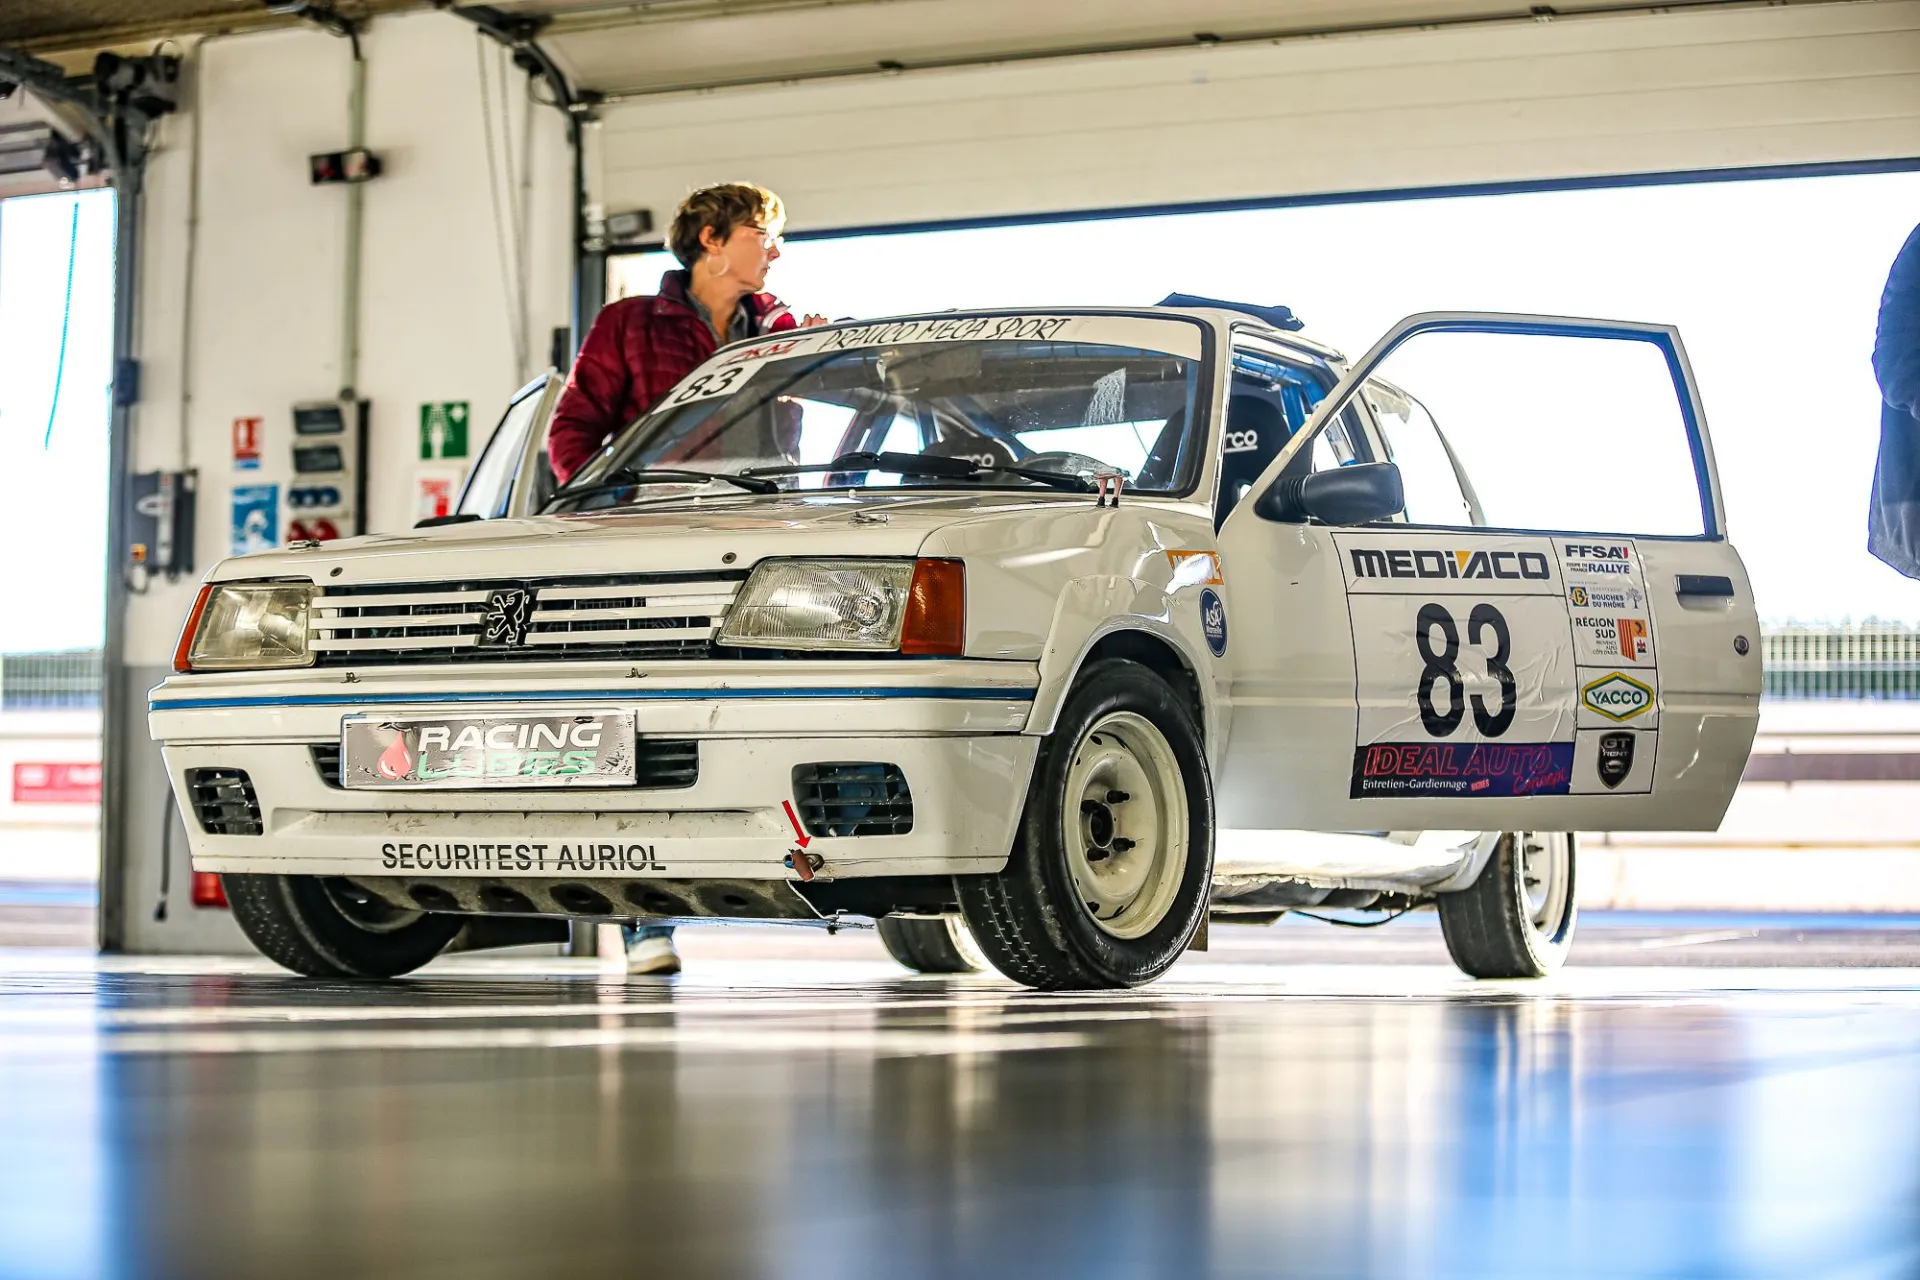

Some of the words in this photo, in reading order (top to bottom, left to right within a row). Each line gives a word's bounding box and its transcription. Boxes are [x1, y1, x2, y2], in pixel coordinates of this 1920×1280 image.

[915, 318, 987, 341] MECA
[985, 316, 1073, 341] SPORT
[673, 367, 744, 404] 83
[1565, 544, 1624, 559] FFSA
[1588, 562, 1630, 575] RALLYE
[1591, 593, 1624, 602] BOUCHES
[1603, 601, 1626, 609] RHÔNE
[1575, 616, 1615, 628] RÉGION
[1595, 629, 1616, 639] SUD
[1416, 603, 1518, 738] 83
[1592, 691, 1643, 705] YACCO
[418, 722, 603, 751] RACING
[1603, 738, 1631, 749] GT
[1363, 745, 1460, 777] IDEAL
[1462, 744, 1552, 776] AUTO
[1362, 778, 1467, 792] Entretien-Gardiennage
[381, 843, 548, 870] SECURITEST
[556, 844, 667, 871] AURIOL
